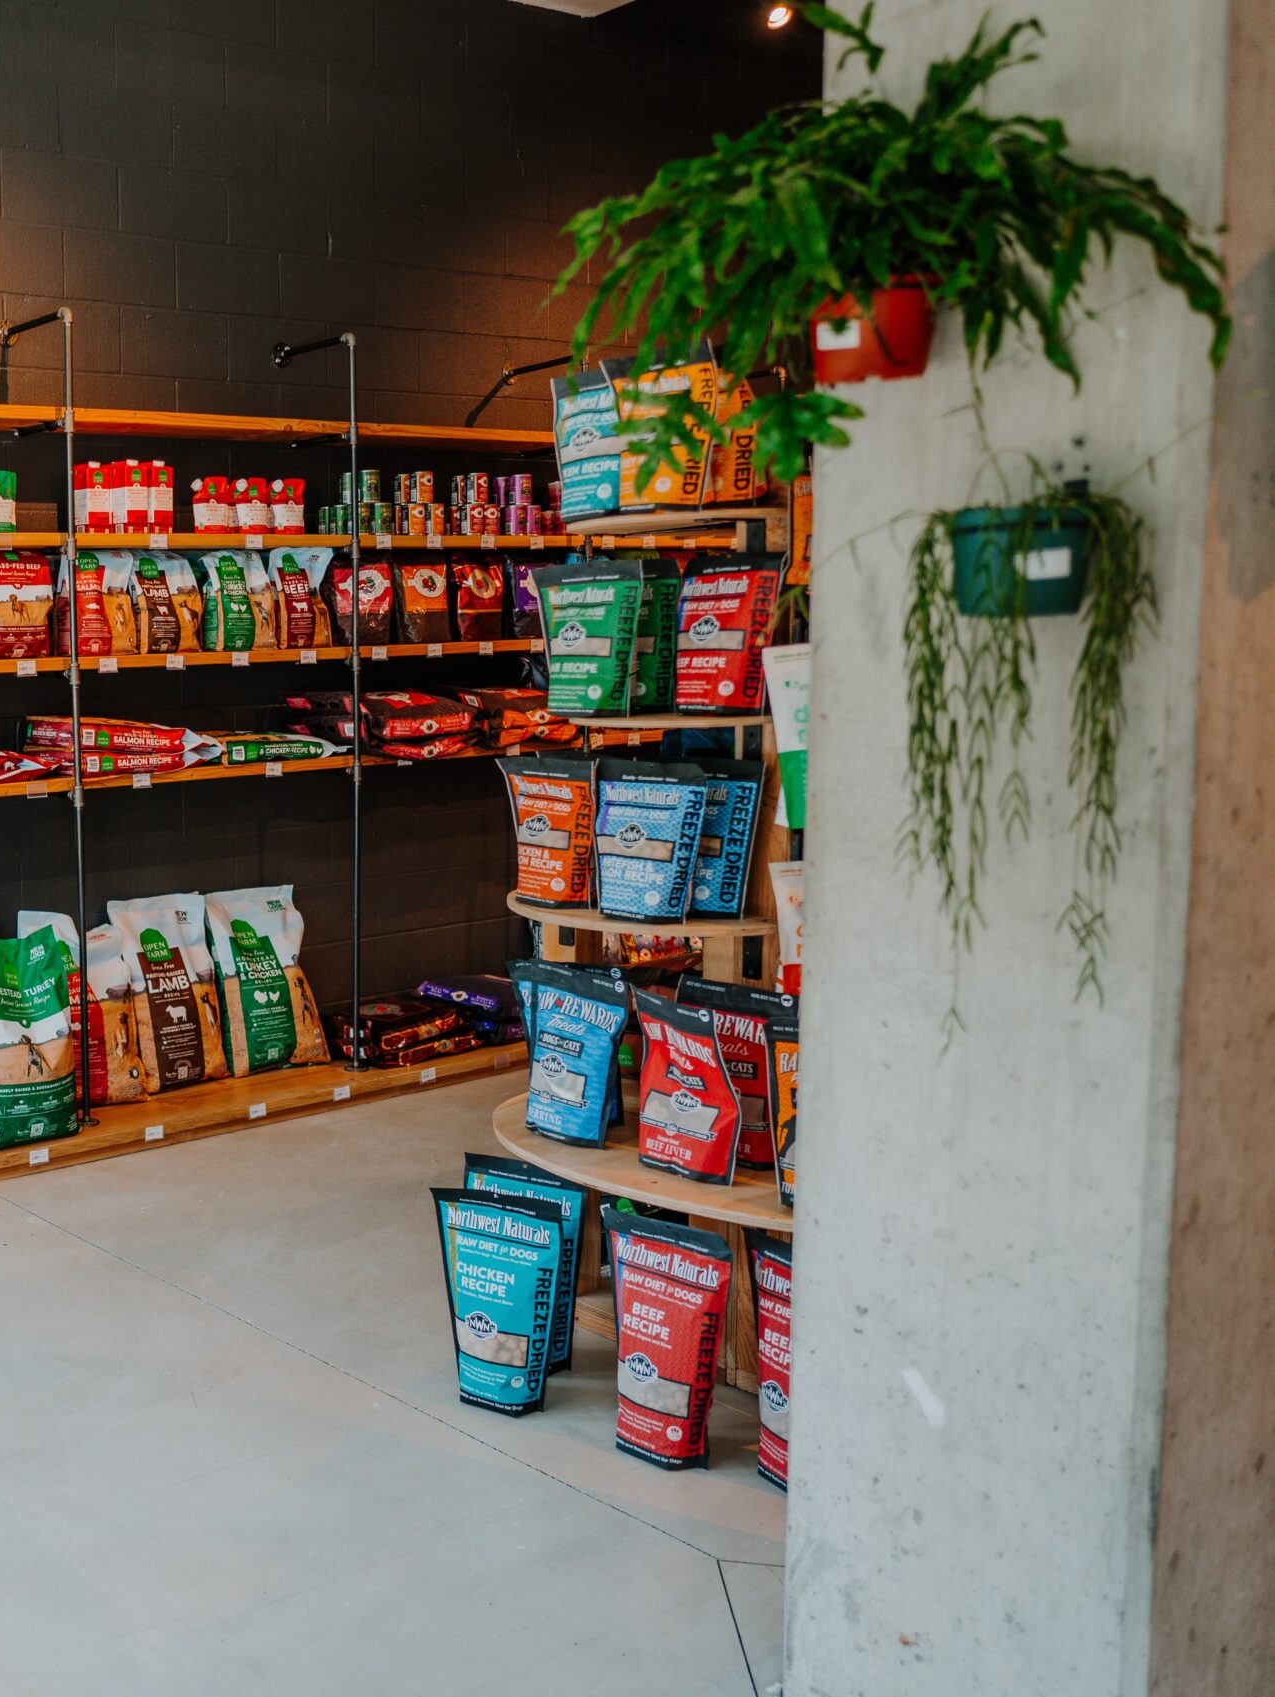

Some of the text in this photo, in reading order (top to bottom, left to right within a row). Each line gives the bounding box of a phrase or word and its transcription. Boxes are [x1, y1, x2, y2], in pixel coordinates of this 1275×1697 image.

[581, 462, 619, 474] RECIPE
[733, 435, 753, 495] DRIED
[145, 588, 169, 597] LAMB
[284, 585, 309, 593] BEEF
[682, 576, 748, 596] Northwest Naturals
[658, 583, 674, 645] FREEZE
[720, 600, 740, 608] DOGS
[617, 586, 639, 647] FREEZE
[563, 663, 598, 673] RECIPE
[657, 649, 673, 697] DRIED
[691, 657, 726, 668] RECIPE
[742, 645, 762, 699] DRIED
[611, 652, 629, 700] DRIED
[114, 736, 170, 746] SALMON RECIPE
[117, 756, 172, 767] SALMON RECIPE
[606, 786, 679, 804] Northwest Naturals
[553, 803, 571, 811] DOGS
[575, 786, 591, 839] FREEZE
[727, 786, 752, 848] FREEZE
[679, 789, 704, 853] FREEZE
[531, 858, 563, 870] RECIPE
[543, 850, 549, 859] &
[570, 845, 589, 894] DRIED
[626, 871, 664, 885] RECIPE
[719, 852, 742, 904] DRIED
[667, 857, 691, 908] DRIED
[143, 942, 165, 950] OPEN
[147, 950, 168, 958] FARM
[237, 960, 277, 972] TURKEY
[248, 969, 282, 979] CHICKEN
[23, 977, 55, 998] TURKEY
[148, 976, 190, 993] LAMB
[547, 1013, 586, 1035] Treats
[560, 995, 620, 1034] REWARDS
[543, 1033, 581, 1052] DOGS CATS
[731, 1063, 753, 1073] CATS
[684, 1076, 702, 1086] CATS
[645, 1138, 665, 1152] BEEF
[665, 1144, 692, 1161] LIVER
[446, 1206, 550, 1245] Northwest Naturals
[456, 1236, 477, 1248] RAW
[478, 1240, 499, 1252] DIET
[509, 1247, 538, 1261] DOGS
[456, 1261, 515, 1285] CHICKEN
[617, 1237, 719, 1288] Northwest Naturals
[461, 1276, 507, 1298] RECIPE
[623, 1270, 703, 1304] RAW DIET DOGS
[533, 1267, 553, 1331] FREEZE
[632, 1302, 665, 1322] BEEF
[469, 1318, 491, 1332] NWN
[553, 1303, 569, 1356] DRIED
[623, 1313, 670, 1340] RECIPE
[696, 1312, 719, 1382] FREEZE
[526, 1337, 547, 1393] DRIED
[630, 1362, 653, 1376] NWN
[688, 1389, 711, 1445] DRIED
